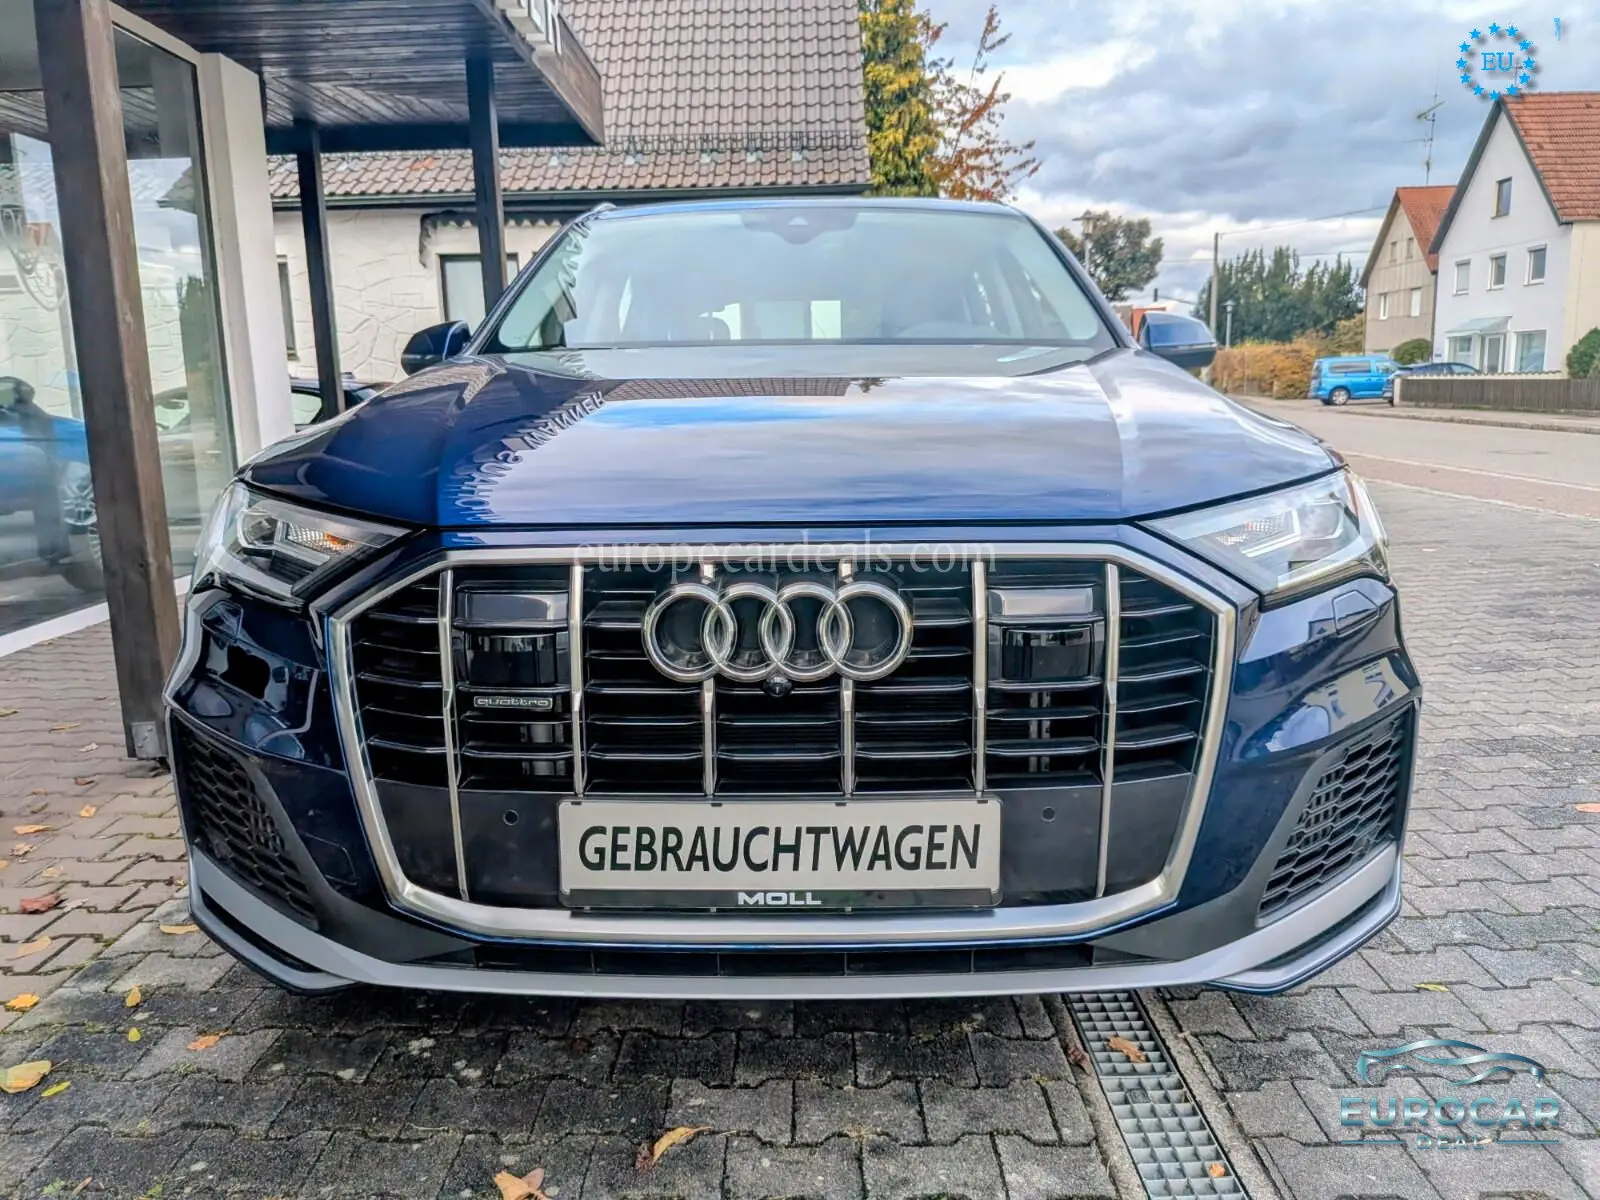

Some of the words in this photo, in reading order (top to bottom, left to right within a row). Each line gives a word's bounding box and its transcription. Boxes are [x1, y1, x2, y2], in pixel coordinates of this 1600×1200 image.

[477, 697, 549, 707] quattro
[578, 824, 981, 872] GEBRAUCHTWAGEN
[737, 892, 822, 905] MOLL
